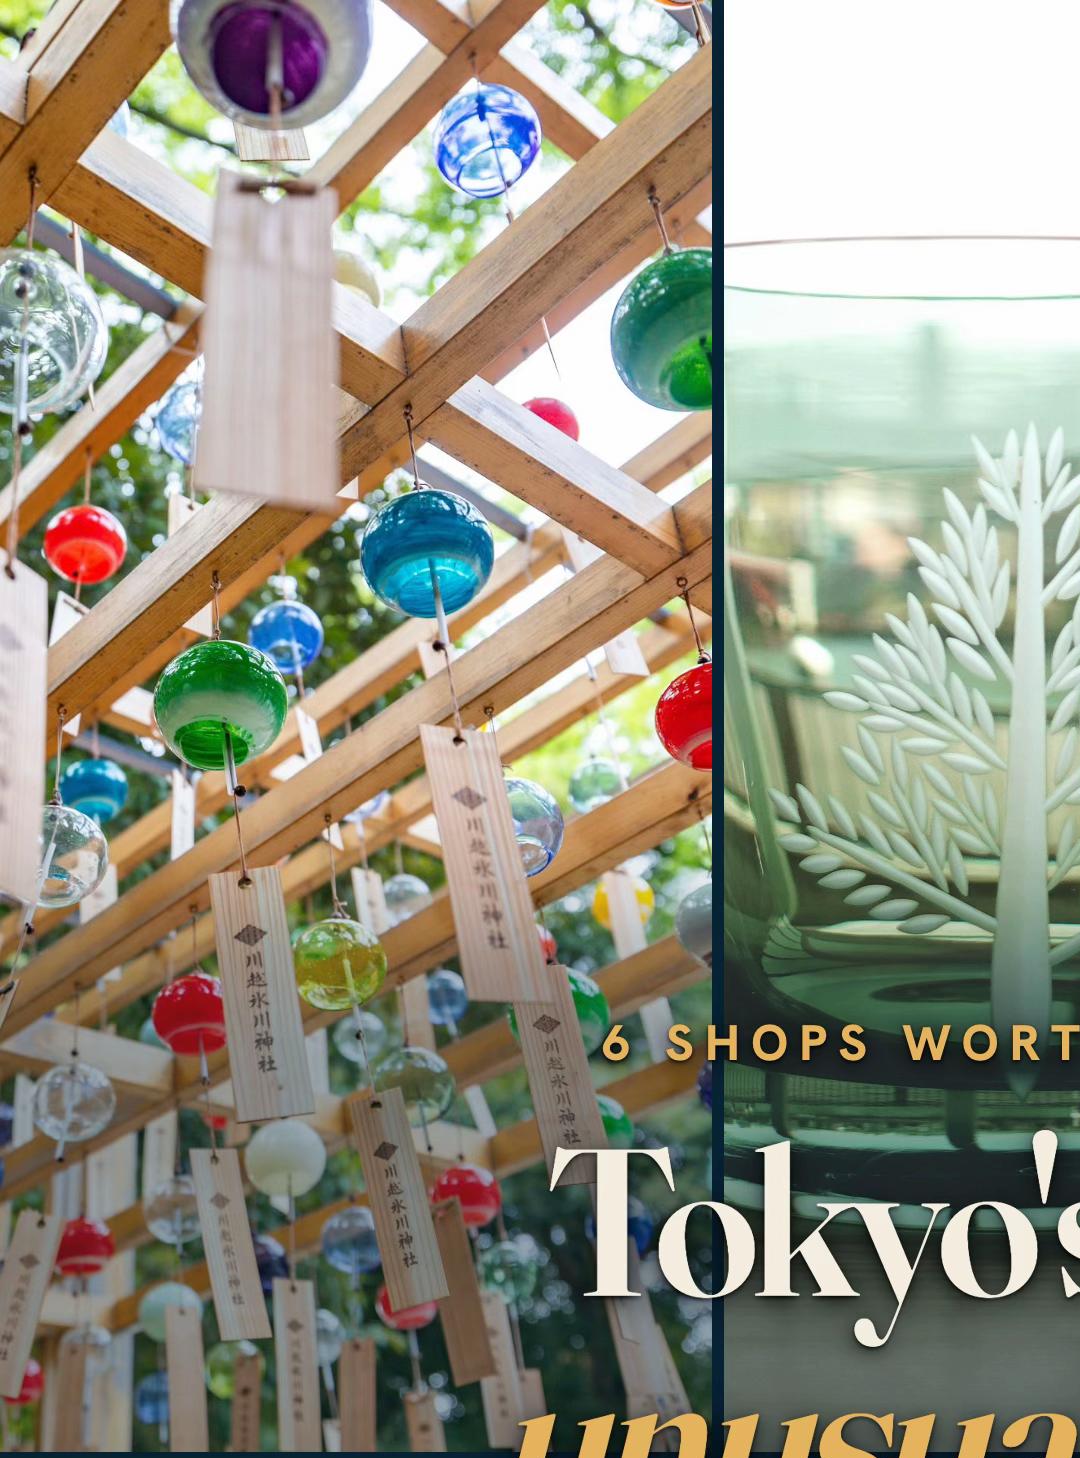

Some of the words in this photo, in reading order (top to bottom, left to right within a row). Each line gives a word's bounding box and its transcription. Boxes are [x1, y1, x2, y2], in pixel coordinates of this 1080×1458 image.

[466, 816, 510, 951] 川越氷川神社
[245, 951, 278, 1074] 川越氷川神社
[544, 1037, 582, 1146] 川越氷川神社
[384, 1163, 419, 1269] 川越氷川神社
